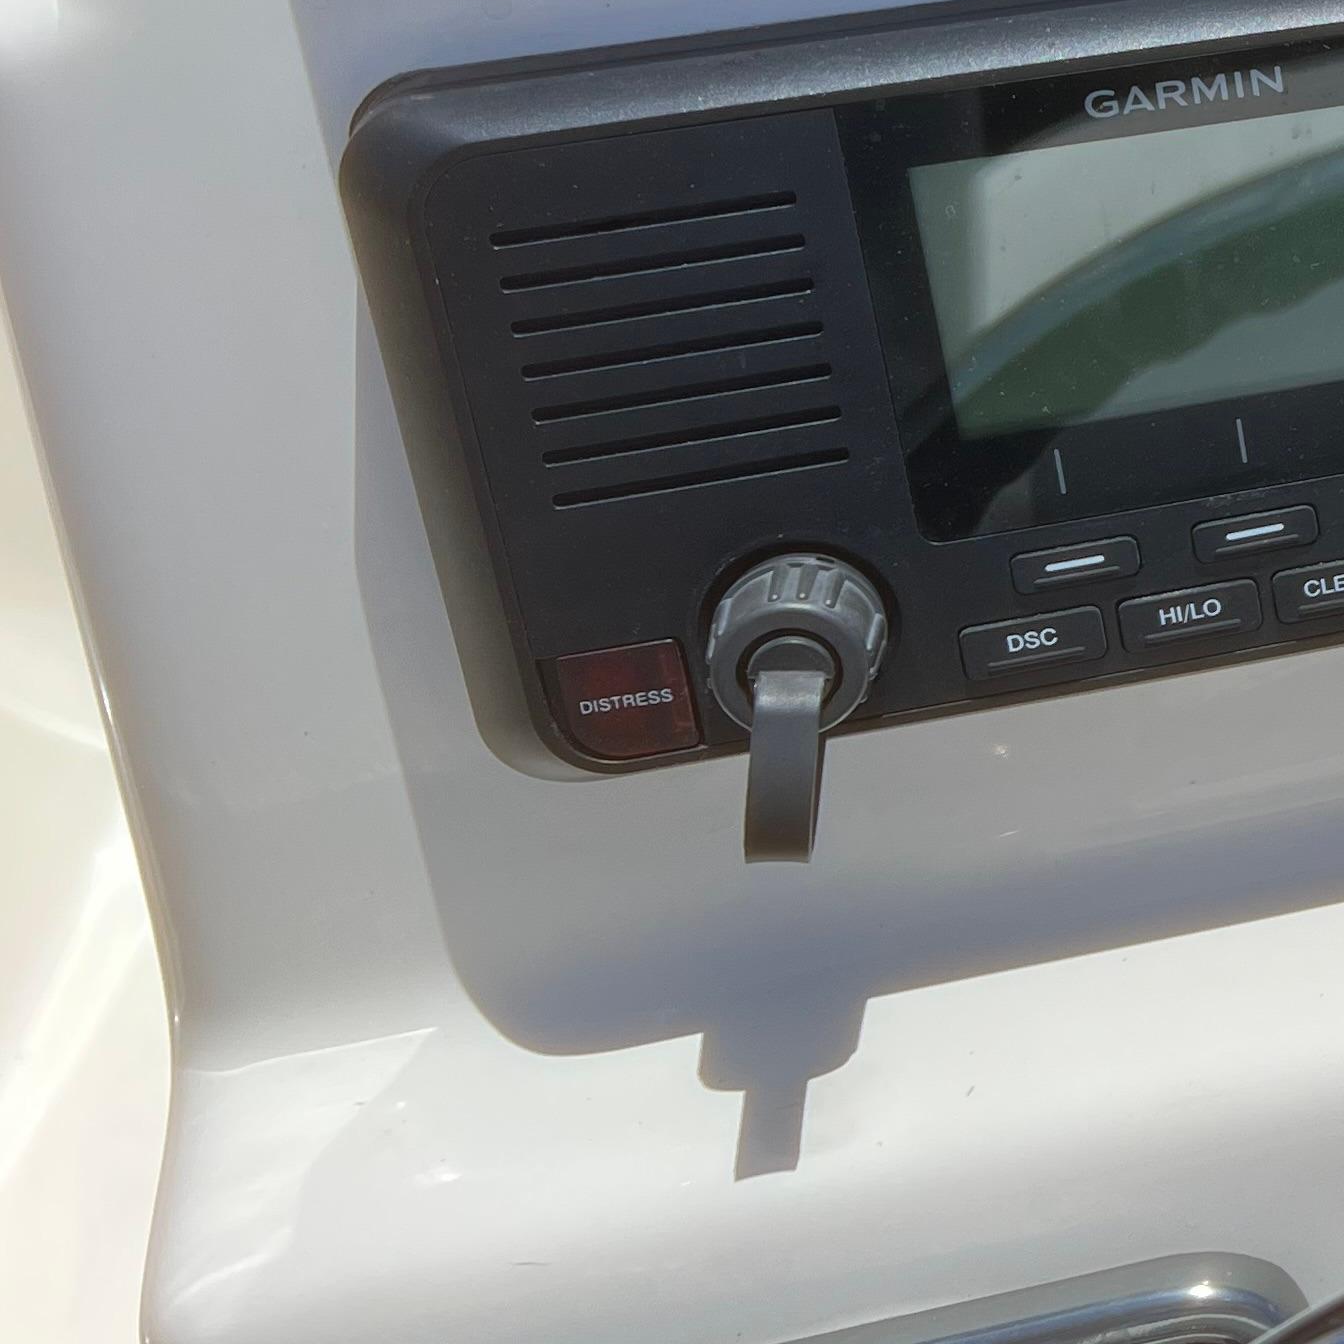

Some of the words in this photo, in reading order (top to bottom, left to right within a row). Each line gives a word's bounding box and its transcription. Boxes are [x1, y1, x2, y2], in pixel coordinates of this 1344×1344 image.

[1083, 65, 1284, 118] GARMIN
[1158, 598, 1222, 626] HI/LO
[1006, 626, 1058, 654] DSC
[579, 688, 674, 715] DISTRESS
